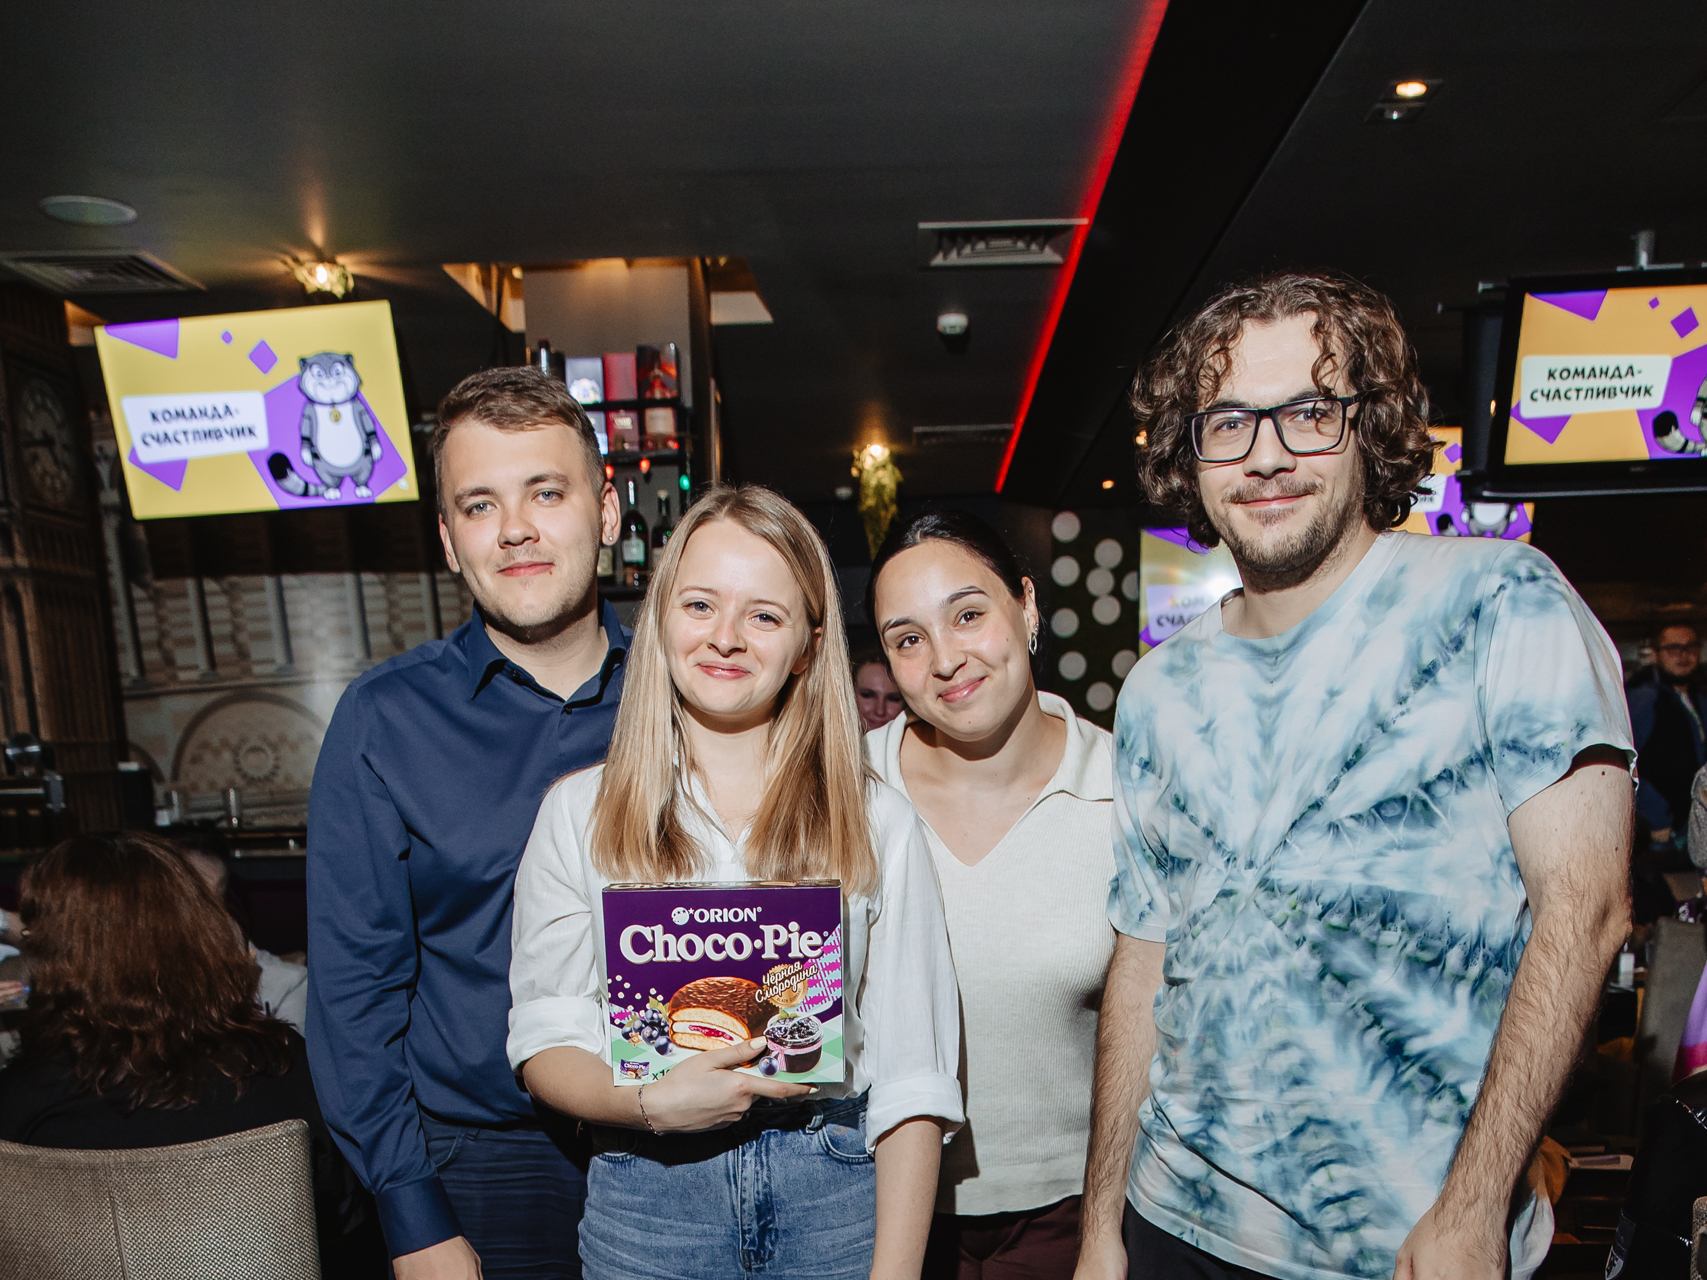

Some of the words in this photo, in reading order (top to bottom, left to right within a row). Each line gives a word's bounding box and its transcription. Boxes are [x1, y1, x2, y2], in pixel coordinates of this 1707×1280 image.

[1547, 364, 1642, 381] КОМАНДА-
[1530, 384, 1654, 401] СЧАСТЛИВЧИК
[150, 403, 240, 423] КОМАНДА-
[140, 426, 257, 447] СЧАСТЛИВЧИК
[755, 964, 819, 1003] Смородина
[762, 961, 803, 986] Чёрная
